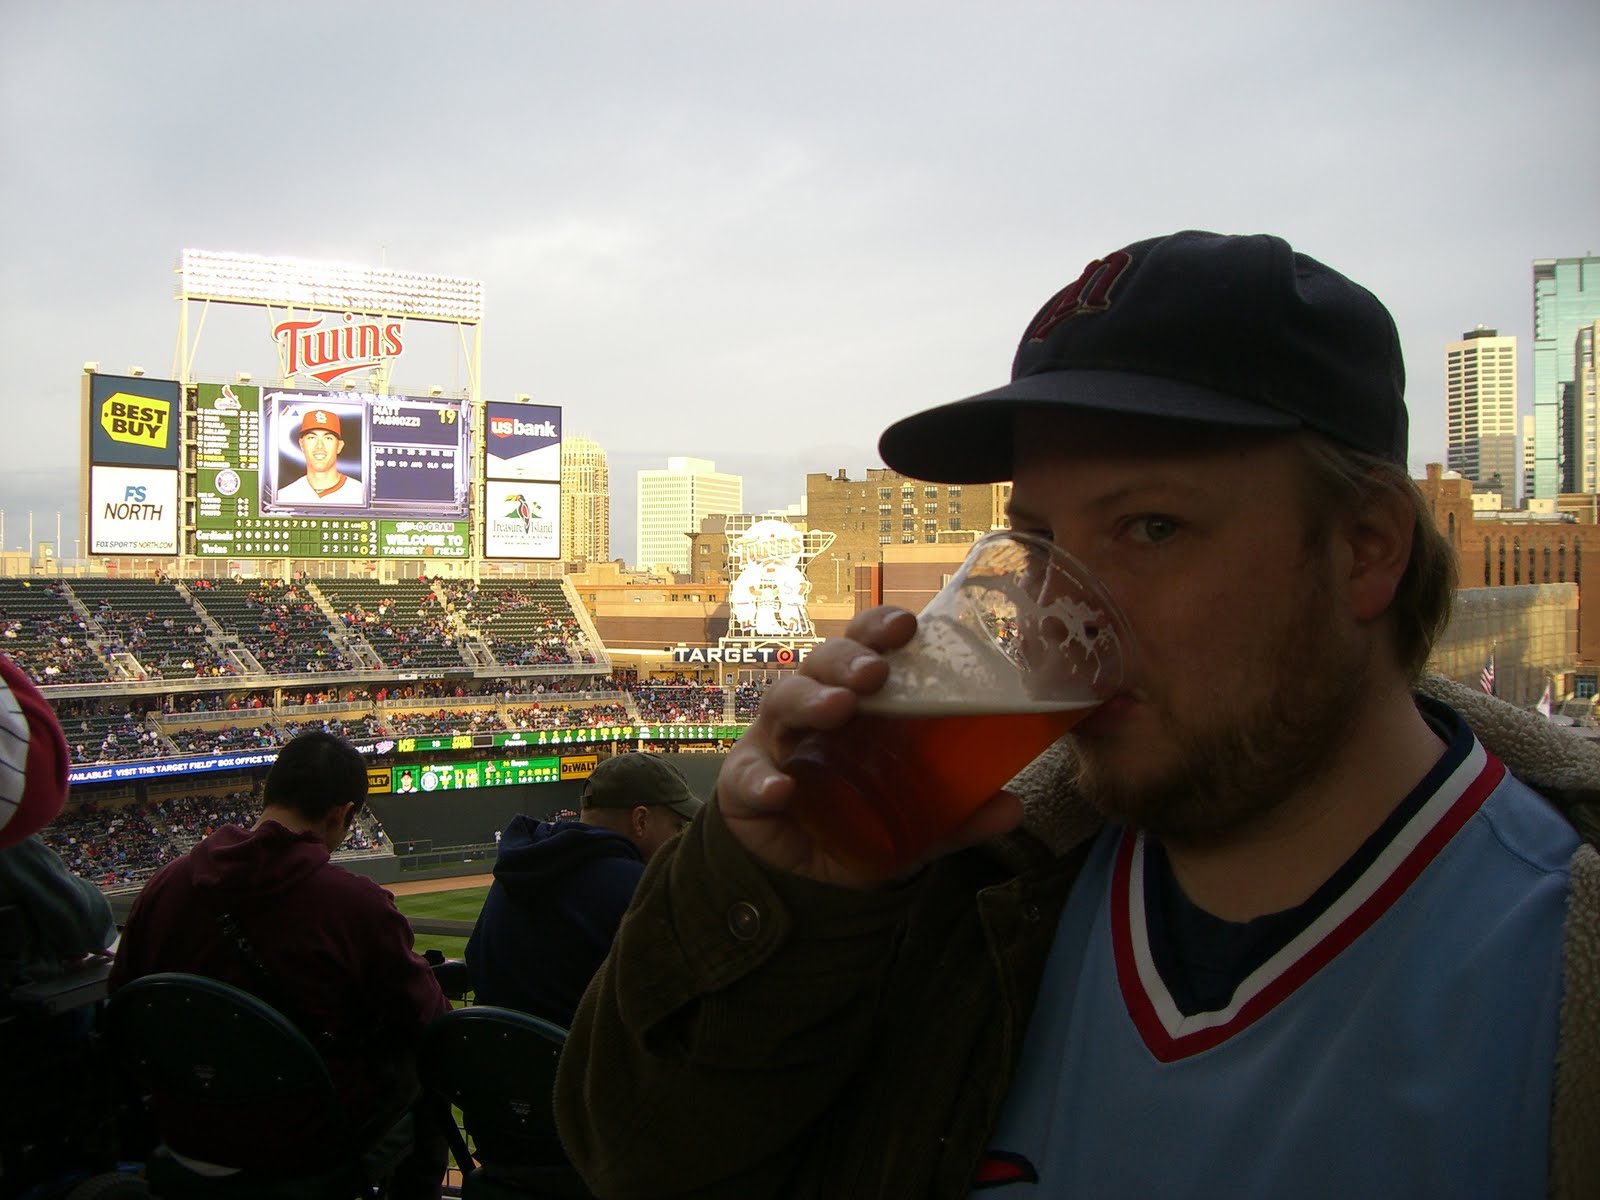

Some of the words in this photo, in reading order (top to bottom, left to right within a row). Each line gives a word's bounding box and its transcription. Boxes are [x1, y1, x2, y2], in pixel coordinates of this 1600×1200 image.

[272, 312, 405, 378] Twins
[111, 402, 167, 424] BEST
[373, 405, 400, 416] MATT
[438, 409, 456, 424] 19
[112, 418, 162, 439] BUY
[124, 486, 146, 502] FS
[104, 503, 163, 520] NORTH
[369, 532, 377, 543] 2
[385, 534, 445, 546] WELCOME
[446, 535, 464, 546] TO
[369, 545, 377, 555] 2
[382, 546, 425, 556] TARGET
[733, 535, 802, 570] Twins
[674, 647, 774, 663] TARGET
[116, 767, 136, 777] VISIT
[139, 765, 155, 774] THE
[156, 761, 188, 773] TARGET
[218, 758, 234, 767] BOX
[235, 755, 262, 765] OFFICE
